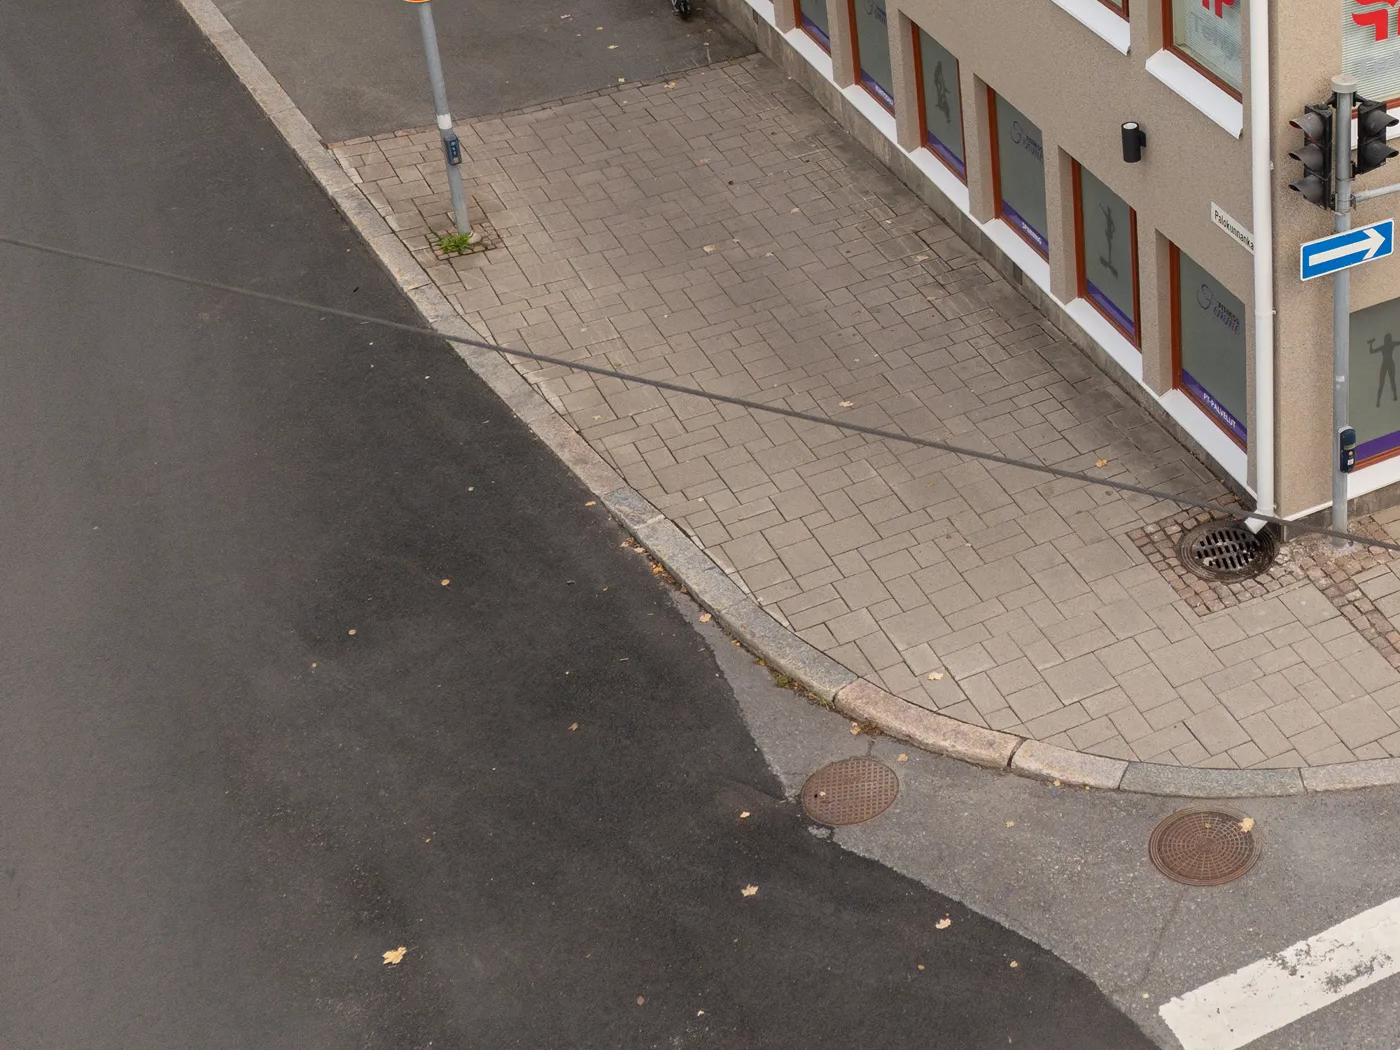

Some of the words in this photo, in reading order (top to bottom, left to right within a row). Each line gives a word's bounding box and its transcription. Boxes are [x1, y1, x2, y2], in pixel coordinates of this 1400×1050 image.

[1189, 10, 1239, 63] Tehy
[1217, 302, 1240, 326] FITNESS
[1202, 392, 1237, 428] PT-PALVELUT
